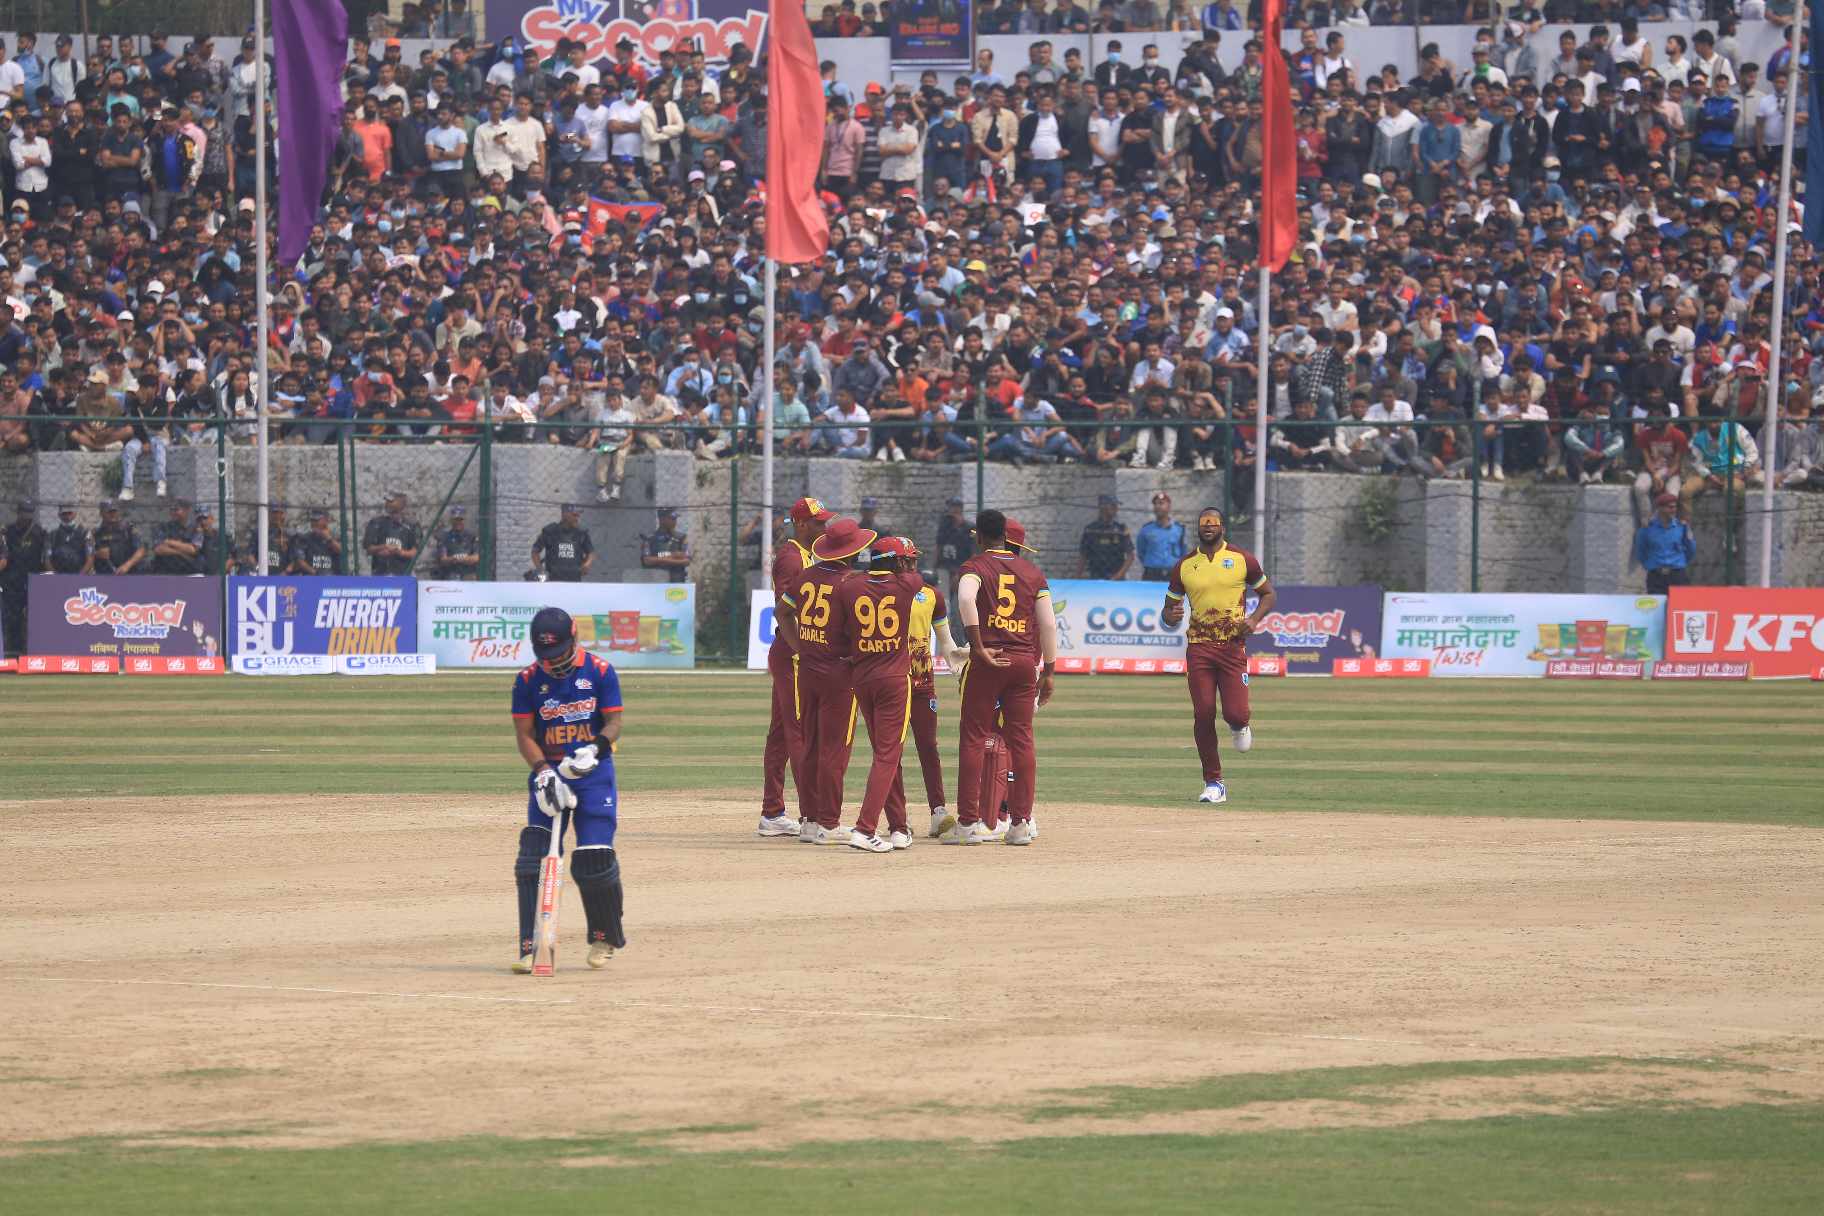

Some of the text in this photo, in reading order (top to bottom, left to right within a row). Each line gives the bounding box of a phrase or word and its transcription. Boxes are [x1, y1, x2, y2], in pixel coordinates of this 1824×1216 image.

[522, 6, 769, 67] Second
[237, 586, 277, 622] KI
[799, 582, 833, 628] 25
[996, 573, 1017, 618] 5
[64, 599, 186, 627] Second
[314, 599, 401, 628] ENERGY
[854, 595, 900, 638] 96
[987, 614, 1026, 633] FORDE
[1254, 609, 1345, 637] cond
[113, 624, 170, 639] Teacher
[237, 621, 294, 655] BU
[432, 616, 531, 641] मसालेद
[799, 625, 829, 645] CHARLE
[1089, 635, 1178, 645] COCONUT WATER
[1396, 625, 1520, 648] मसालेदार
[1723, 614, 1824, 652] KF
[327, 627, 401, 656] DRINK
[469, 637, 521, 662] Twist
[858, 637, 901, 653] CARTY
[264, 656, 322, 666] GRACE
[368, 656, 425, 665] GRACE
[1432, 646, 1483, 668] Twist
[544, 723, 596, 744] NEPAL
